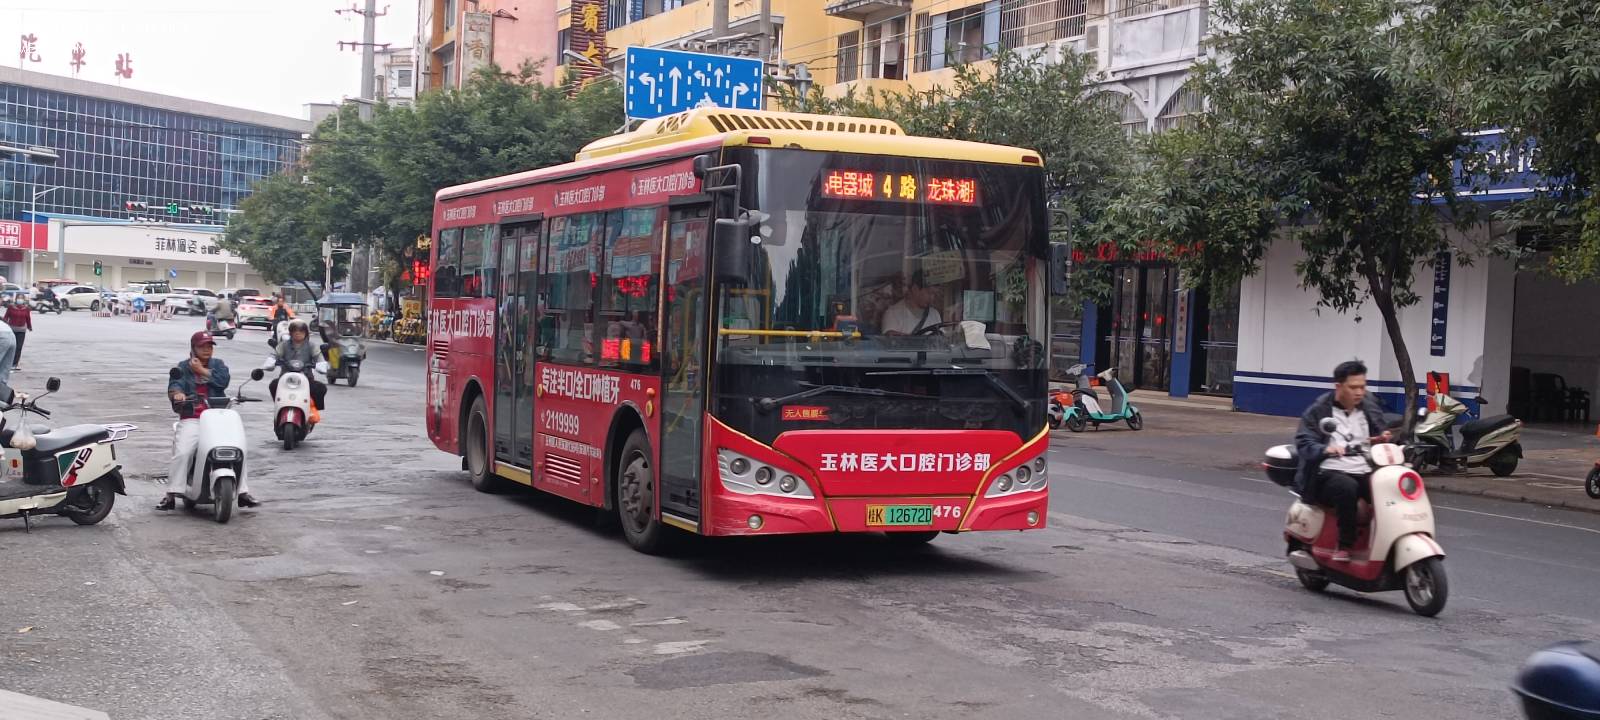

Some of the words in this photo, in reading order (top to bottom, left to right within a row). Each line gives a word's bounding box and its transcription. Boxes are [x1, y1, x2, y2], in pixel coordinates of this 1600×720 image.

[824, 171, 873, 197] 电器城
[883, 174, 892, 198] 4
[900, 174, 916, 199] 路
[928, 178, 975, 203] 龙珠湖
[541, 367, 621, 405] 专注半口/全口种植牙
[630, 378, 641, 390] 476
[545, 410, 579, 436] 2119999
[820, 452, 991, 473] 玉林医大口腔门诊部
[890, 508, 932, 523] 12672D
[933, 505, 961, 518] 476
